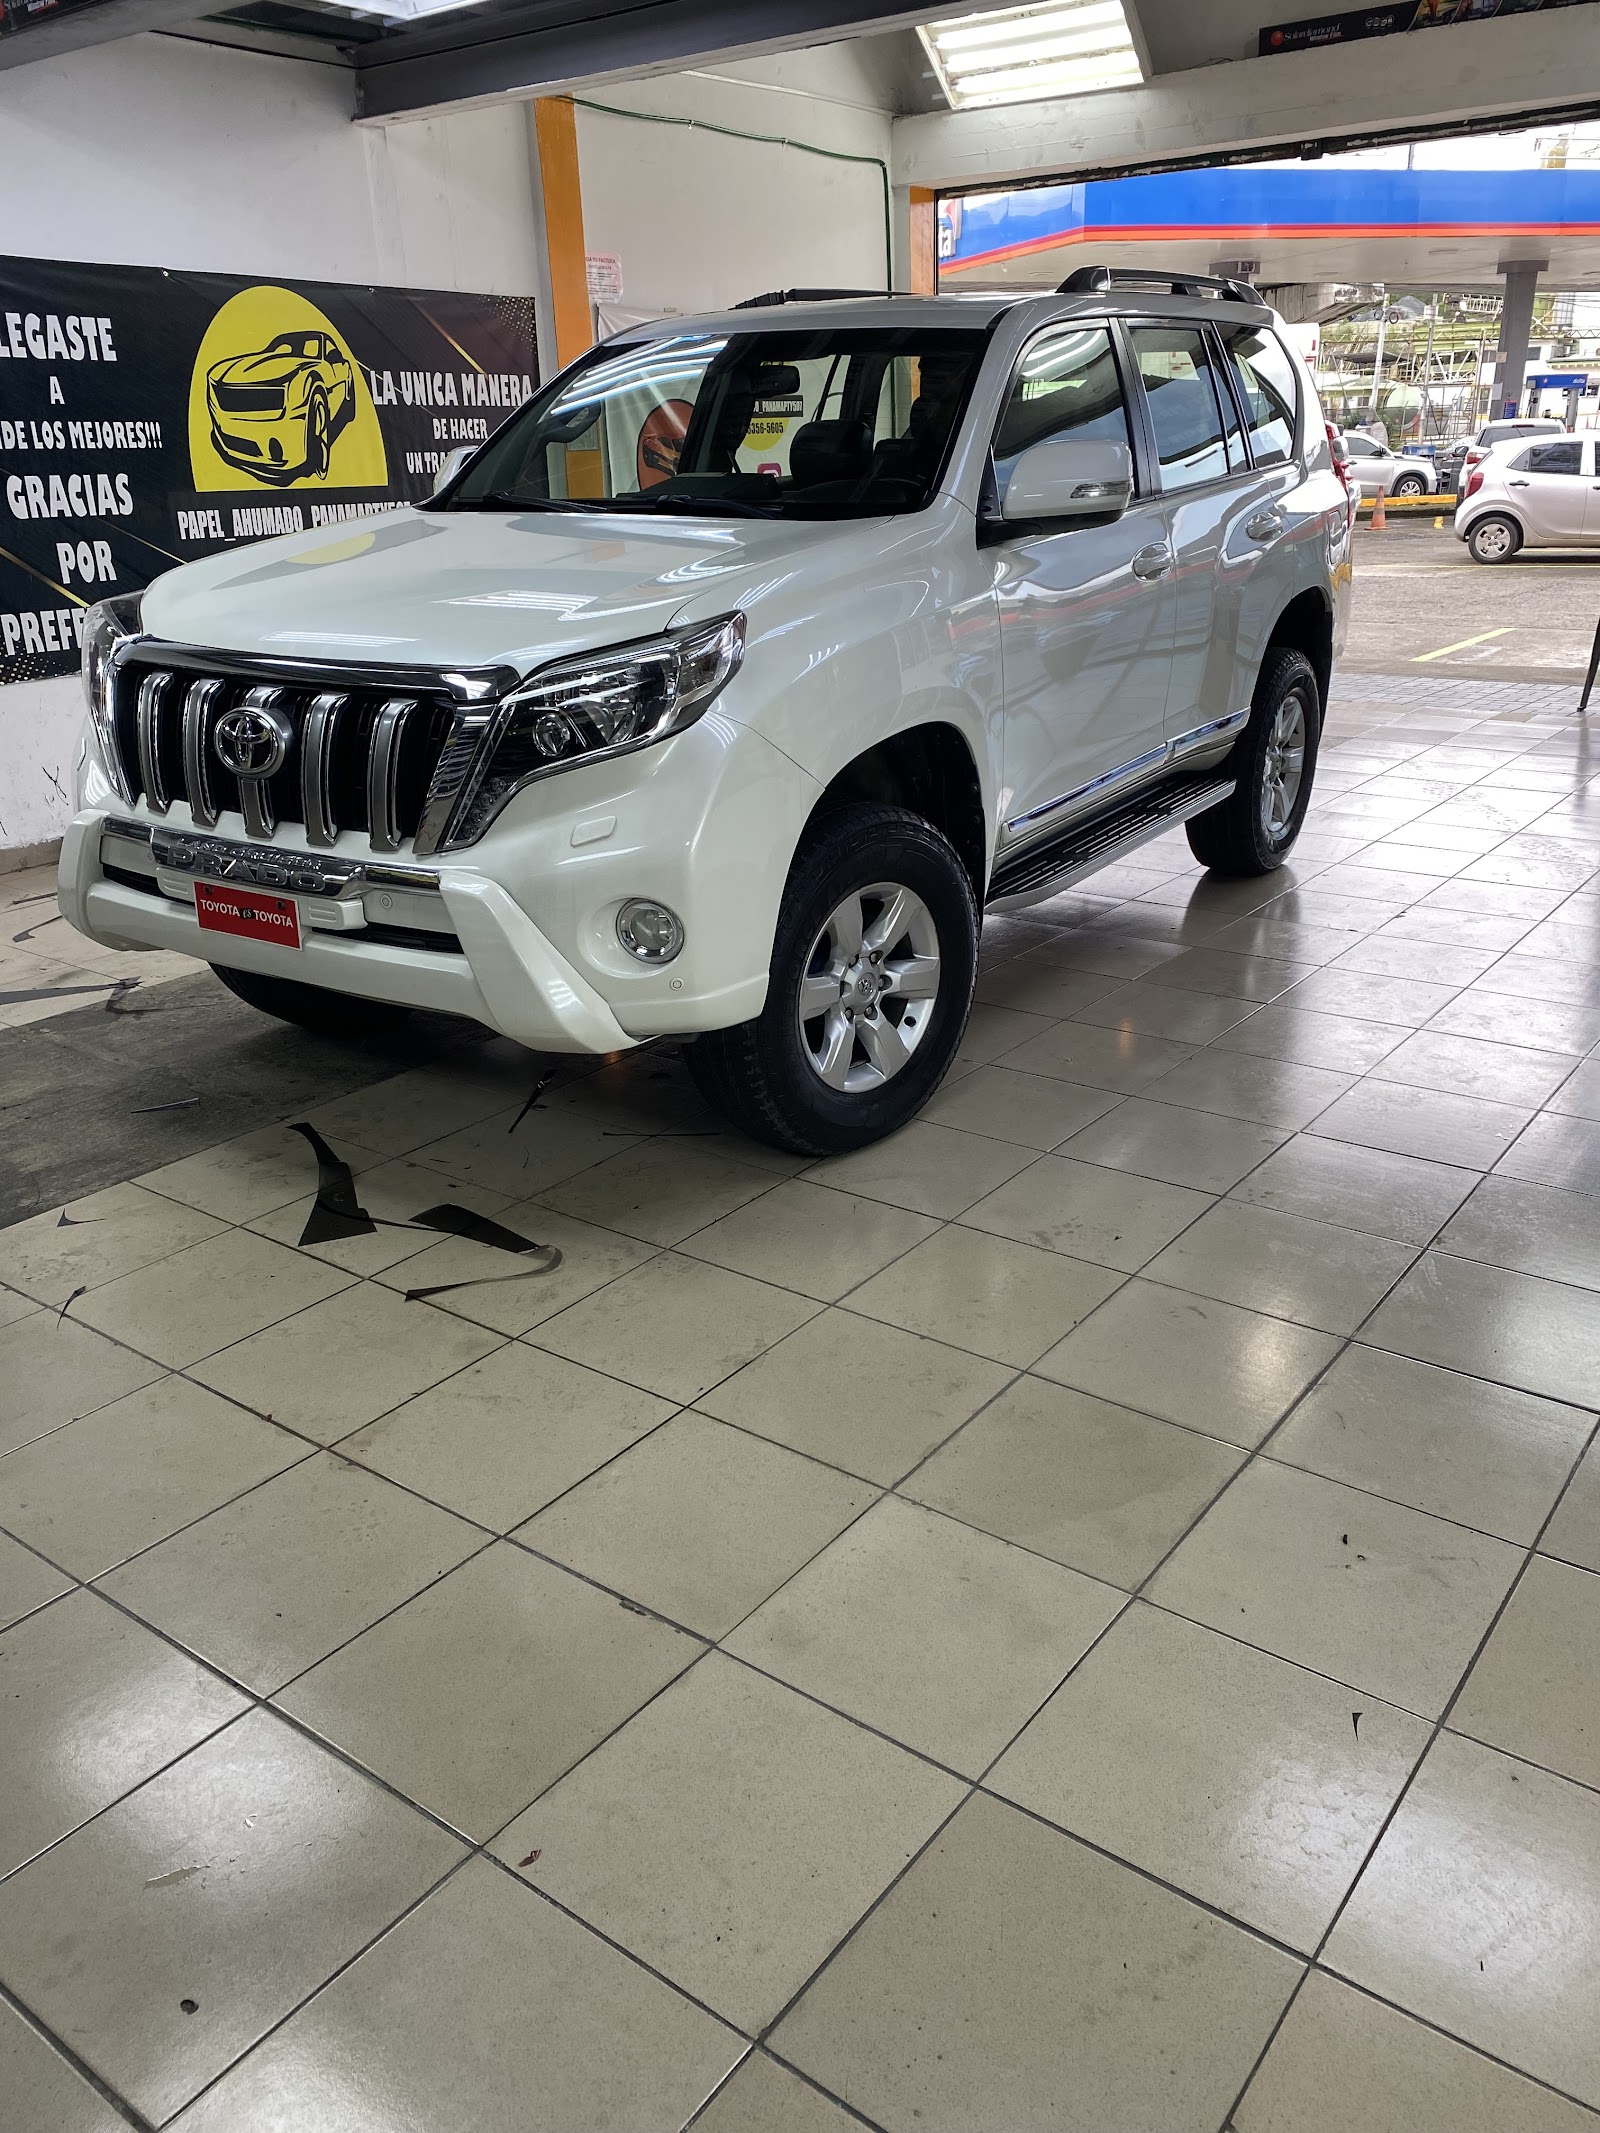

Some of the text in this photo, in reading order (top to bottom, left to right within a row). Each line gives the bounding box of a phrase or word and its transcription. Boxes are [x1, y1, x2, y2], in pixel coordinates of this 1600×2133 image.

[50, 376, 65, 405] A
[370, 370, 533, 407] LA UNICA MANERA
[0, 421, 163, 449] DE LOS MEJORES!!!
[432, 418, 488, 440] DE HACER
[405, 452, 449, 474] UN TRA
[6, 473, 134, 520] GRACIAS
[56, 540, 117, 584] POR
[167, 845, 326, 892] PRADO
[200, 899, 241, 917] TOYOTA
[252, 909, 294, 928] TOYOTA
